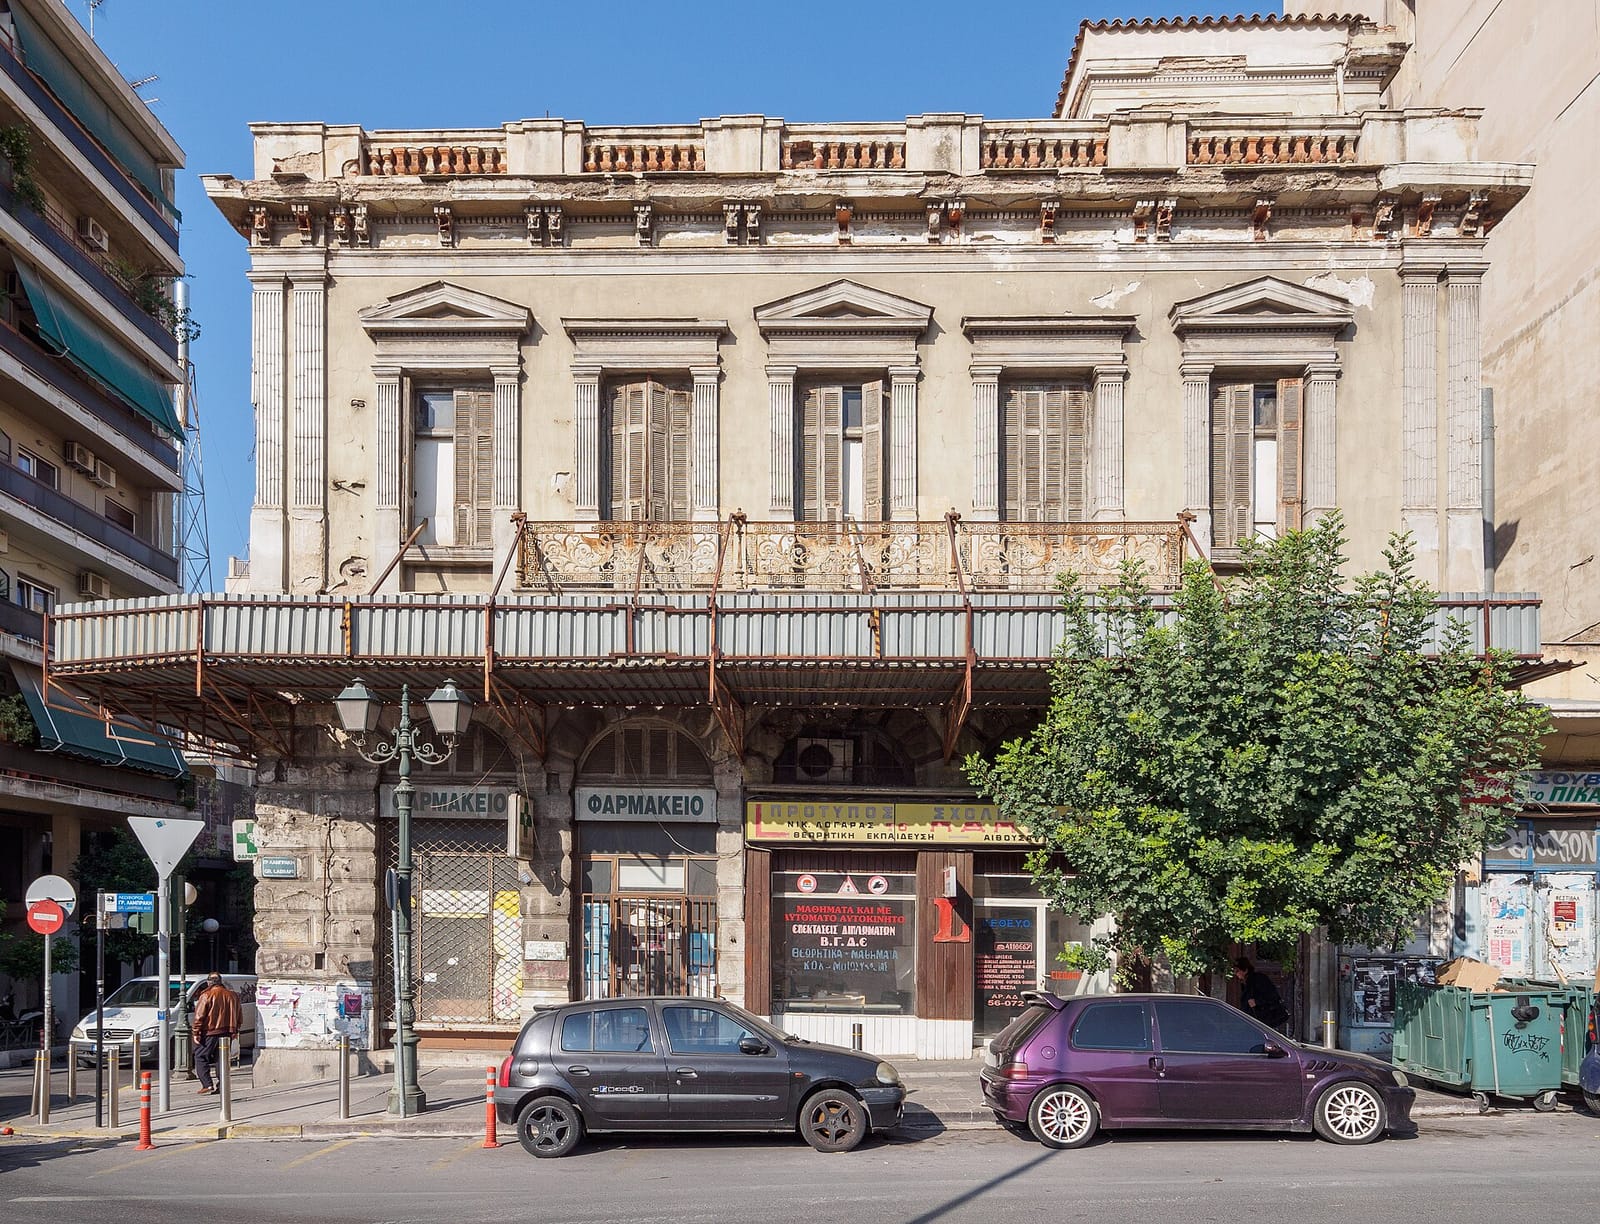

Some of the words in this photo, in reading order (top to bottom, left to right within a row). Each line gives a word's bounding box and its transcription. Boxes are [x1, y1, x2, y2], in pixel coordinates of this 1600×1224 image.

[587, 794, 704, 816] ΦΑΡΜΑΚΕΙΟ
[769, 804, 893, 819] ΠΡΟΤΥΠΟΣ
[815, 821, 874, 829] ΛΟΓΑΡΑΣ
[793, 832, 855, 840] ΘΕΩΡΗΤΙΚΗ
[866, 832, 935, 841] ΕΚΠΑΙΔΕΥΣΗ
[796, 905, 854, 914] ΜΑΘΗΜΑΤΑ
[857, 906, 874, 914] ΚΑΙ
[877, 906, 892, 915] ΜΕ
[840, 914, 906, 924] ΑΥΤΟΚΙΝΗΤΟ
[792, 924, 839, 935] ΕΠΕΚΤΑΣΕΙΣ
[842, 925, 896, 936] ΔΙΠΛΩΜΑΤΩΝ
